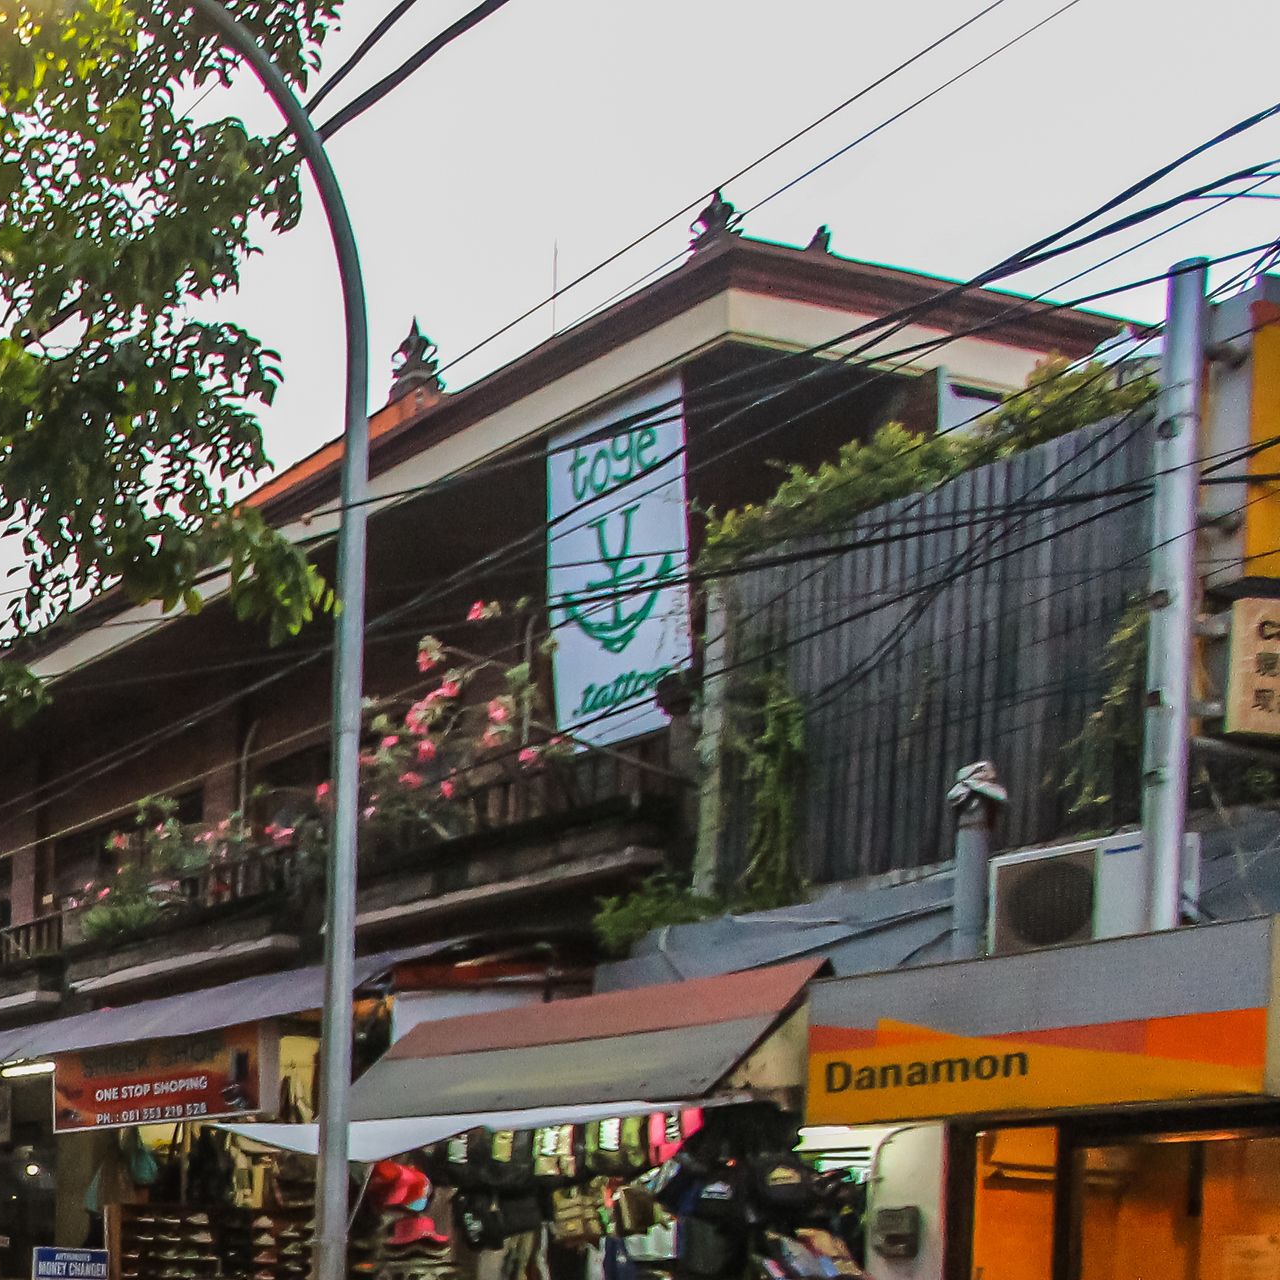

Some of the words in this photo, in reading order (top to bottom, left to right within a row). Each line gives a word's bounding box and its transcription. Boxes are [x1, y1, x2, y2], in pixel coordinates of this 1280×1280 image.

[95, 1086, 119, 1102] ONE
[121, 1083, 151, 1099] STOP
[153, 1075, 208, 1096] SHOPING
[824, 1050, 1028, 1094] Danamon
